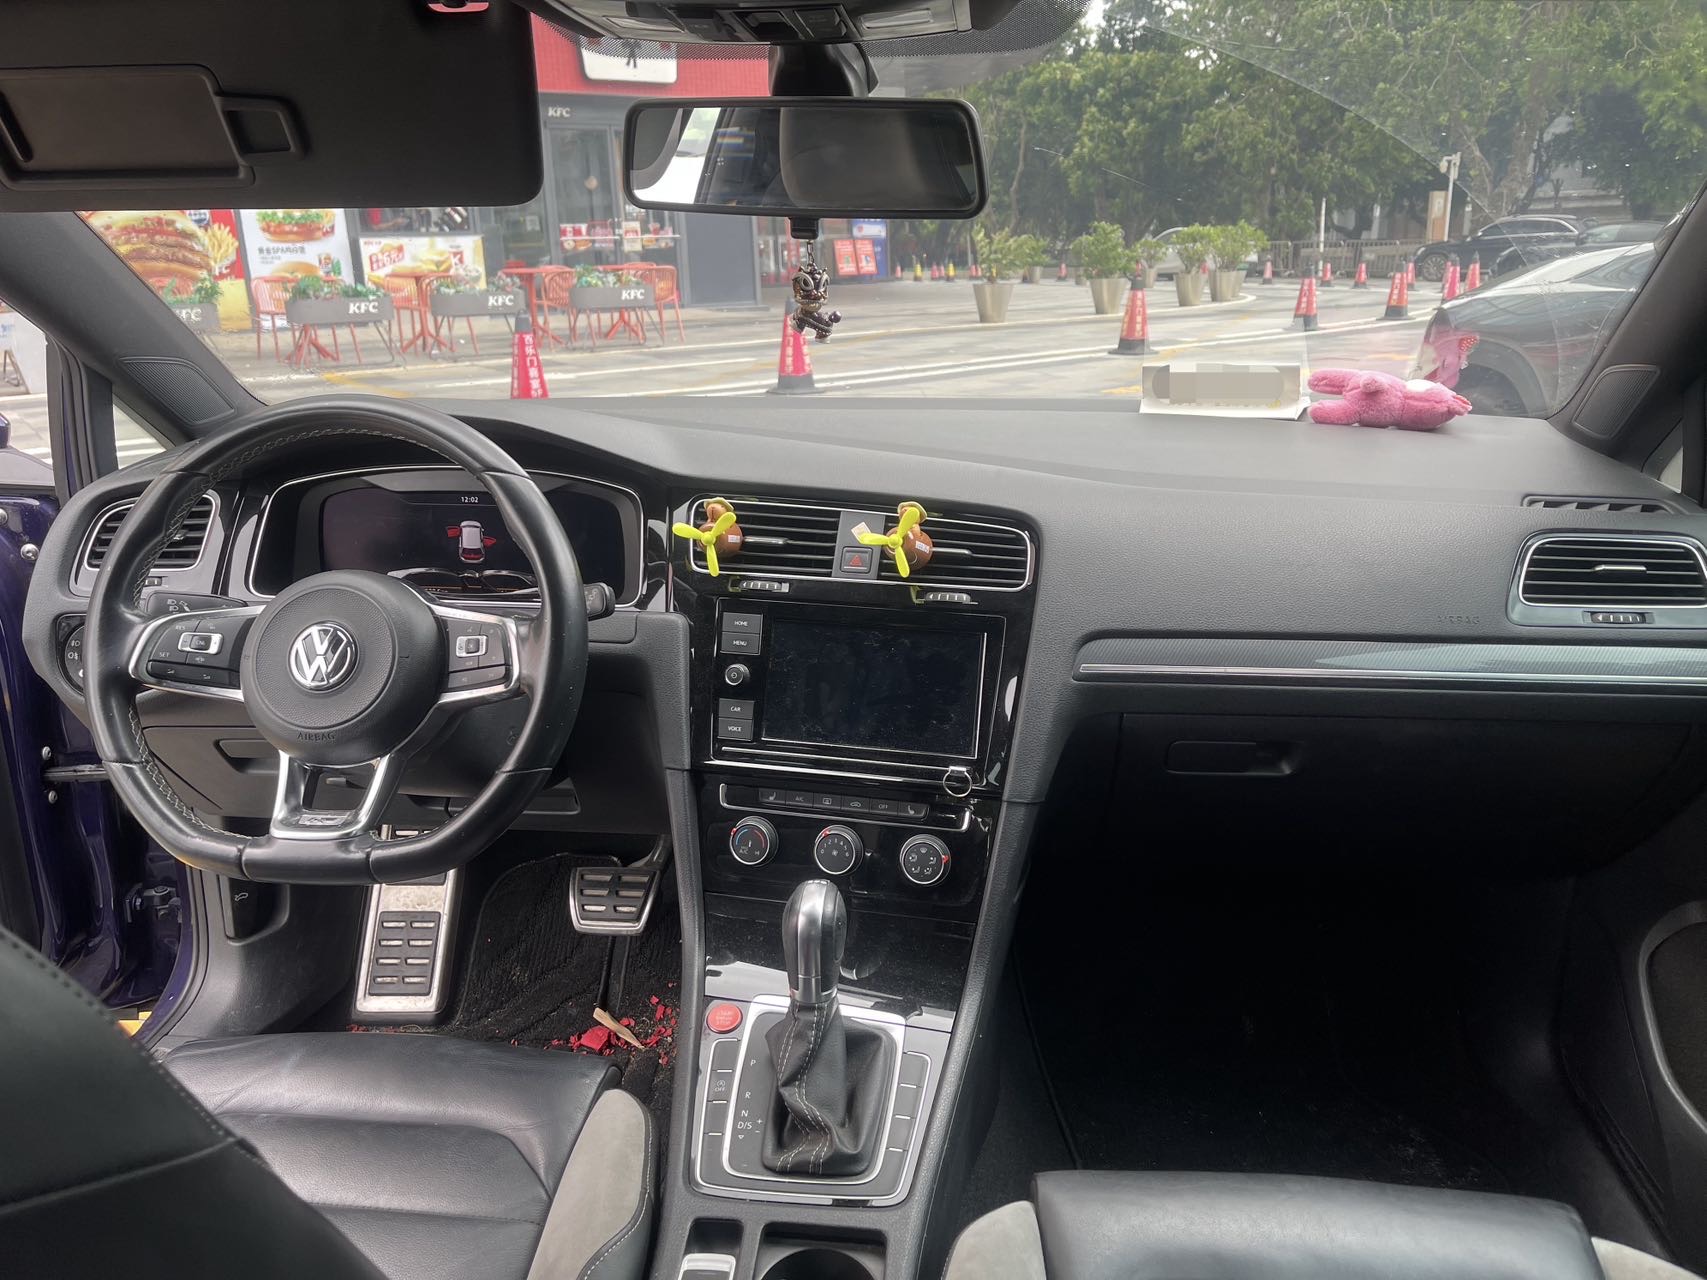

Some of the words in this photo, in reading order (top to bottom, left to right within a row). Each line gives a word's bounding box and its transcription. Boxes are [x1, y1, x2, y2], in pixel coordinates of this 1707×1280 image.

[548, 106, 570, 118] KFC
[622, 289, 645, 300] KFC
[488, 295, 514, 307] KFC
[348, 301, 379, 314] KFC
[297, 732, 337, 742] AIRBAG
[745, 1091, 752, 1099] R
[741, 1109, 749, 1117] N
[737, 1121, 753, 1130] D/S
